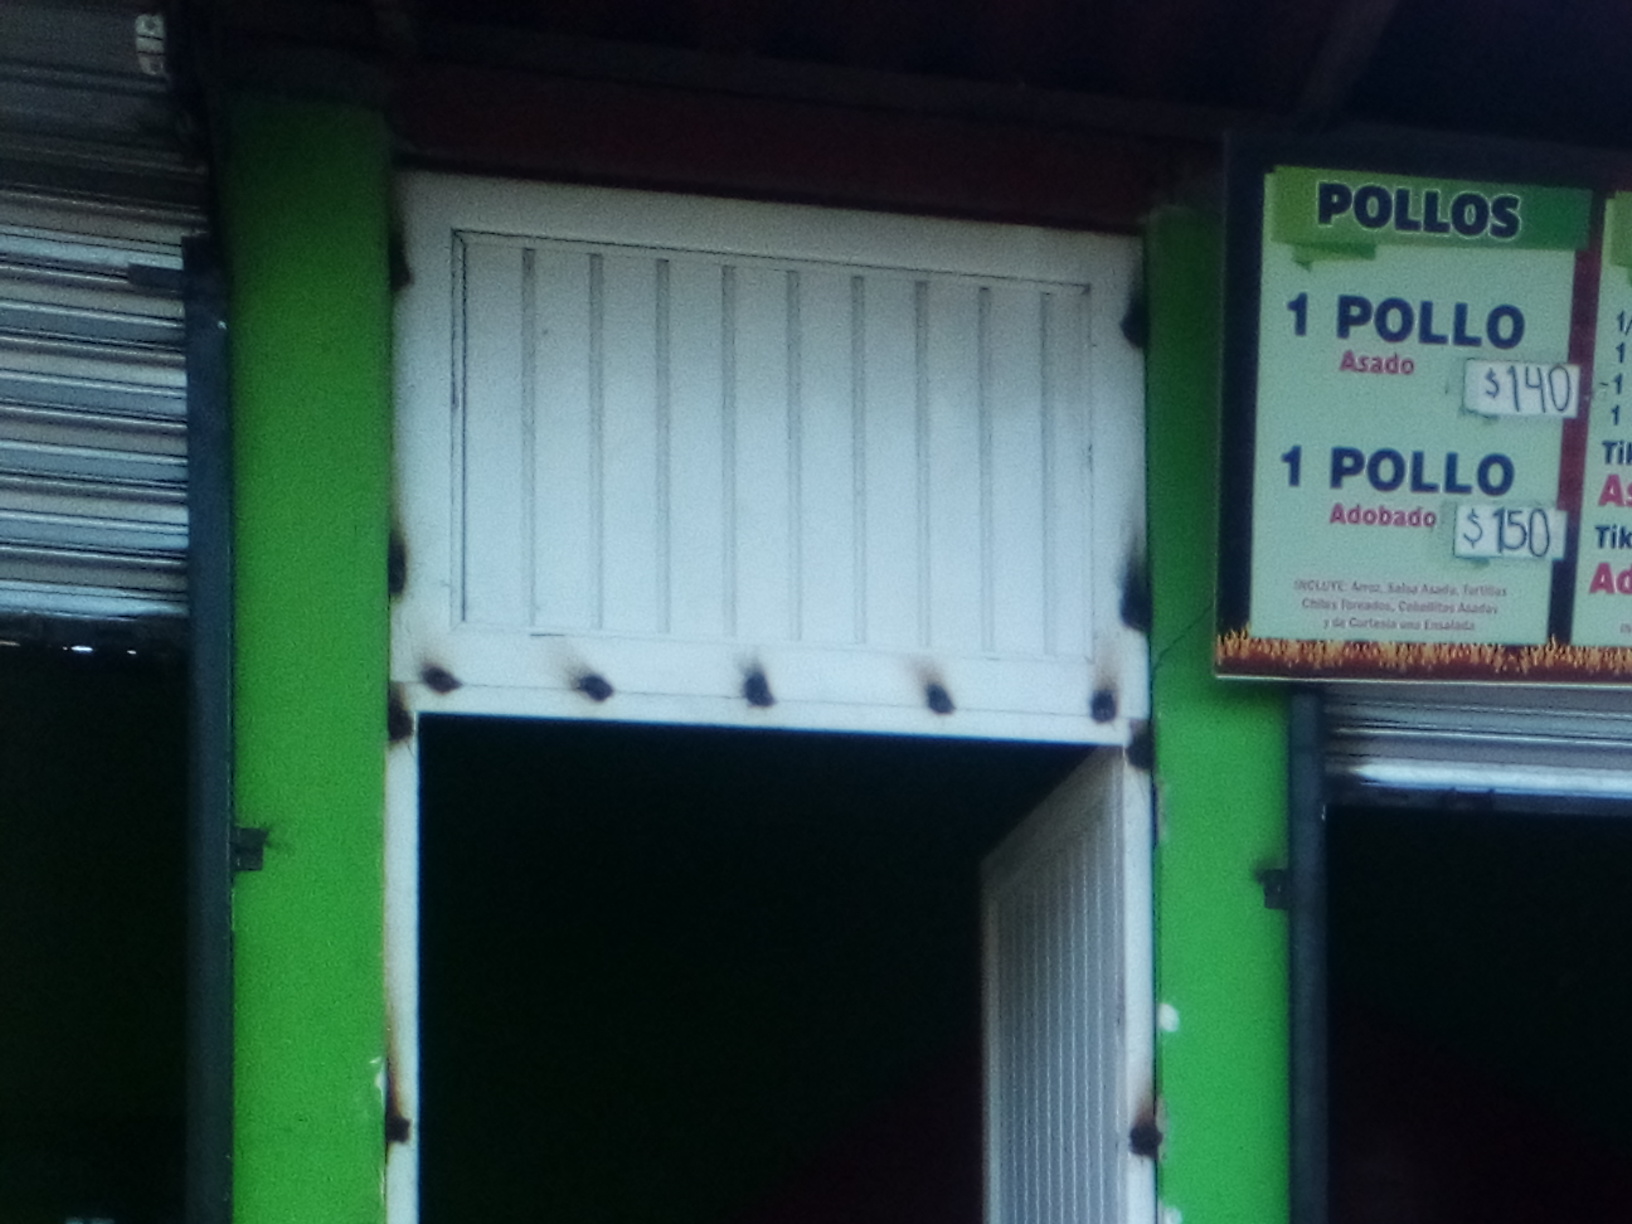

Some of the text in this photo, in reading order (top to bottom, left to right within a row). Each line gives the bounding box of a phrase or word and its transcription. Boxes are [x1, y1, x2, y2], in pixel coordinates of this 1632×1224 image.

[1317, 181, 1521, 239] POLLOS
[1287, 292, 1525, 349] 1 POLLO
[1339, 351, 1415, 376] Asado
[1616, 343, 1625, 364] 1
[1485, 364, 1571, 414] $140
[1613, 373, 1623, 394] 1
[1611, 405, 1620, 426] 1
[1281, 445, 1515, 497] 1 POLLO
[1329, 503, 1437, 528] Adobado
[1462, 507, 1551, 558] $150
